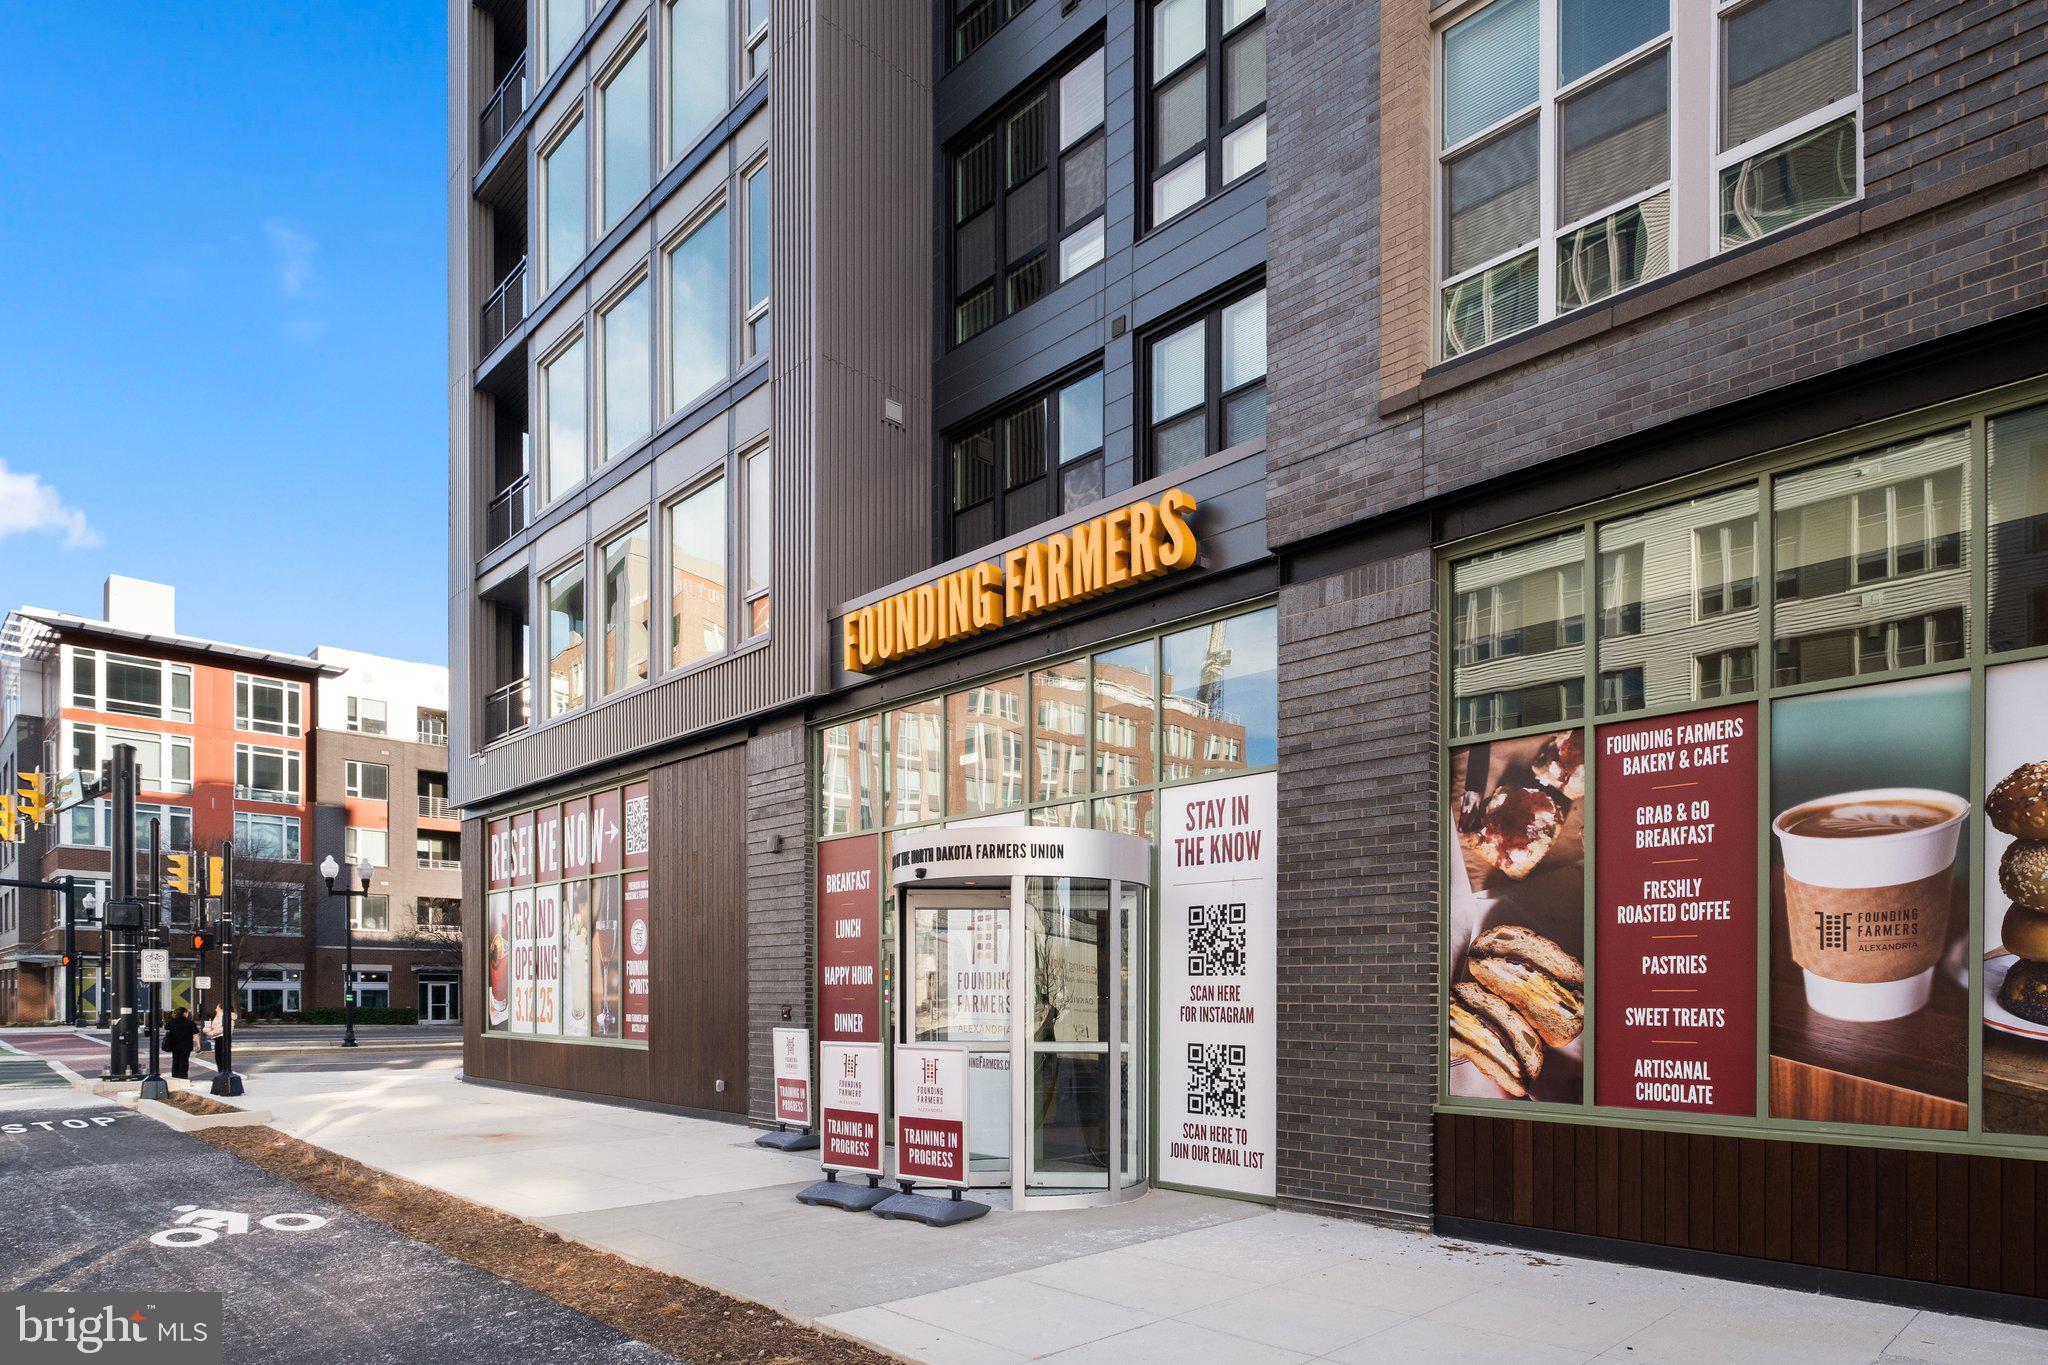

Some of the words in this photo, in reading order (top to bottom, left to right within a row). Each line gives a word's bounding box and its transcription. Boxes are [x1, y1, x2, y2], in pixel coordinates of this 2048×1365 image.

[844, 561, 1003, 672] FOUNDING
[1006, 488, 1197, 622] FARMERS
[1607, 727, 1672, 755] FOUNDING
[1677, 717, 1744, 745] FARMERS
[1623, 751, 1676, 776] BAKERY
[1679, 749, 1690, 769] &
[1693, 744, 1729, 767] CAFE
[1186, 798, 1226, 831] STAY
[1232, 795, 1249, 826] IN
[1636, 804, 1672, 826] GRAB
[1677, 802, 1687, 822] &
[1691, 800, 1710, 820] GO
[564, 808, 605, 868] NOW
[1636, 823, 1715, 849] BREAKFAST
[911, 847, 934, 864] NORTH
[936, 845, 972, 862] DAKOTA
[976, 843, 1027, 860] FARMERS
[1030, 844, 1064, 859] UNION
[1175, 836, 1205, 867] THE
[1210, 830, 1261, 864] KNOW
[826, 870, 871, 894] BREAKFAST
[1643, 877, 1702, 900] FRESHLY
[1617, 903, 1677, 924] ROASTED
[1680, 900, 1731, 922] COFFEE
[1858, 908, 1918, 923] FOUNDING
[835, 918, 861, 939] LUNCH
[1858, 923, 1918, 937] FARMERS
[1858, 942, 1918, 952] ALEXANDRIA
[515, 945, 558, 981] OPENING
[626, 960, 649, 976] FOUNDIN
[1642, 955, 1708, 975] PASTRIES
[824, 967, 851, 986] HAPPY
[851, 965, 873, 985] HOUR
[958, 994, 1011, 1013] FARMERS
[1190, 985, 1214, 1001] SCAN
[1217, 985, 1241, 1002] HERE
[834, 1013, 863, 1033] DINNER
[1180, 1006, 1197, 1023] FOR
[1199, 1007, 1254, 1024] INSTAGRAM
[1625, 1007, 1669, 1027] SWEET
[1672, 1008, 1725, 1028] TREATS
[1634, 1058, 1711, 1081] ARTISANAL
[780, 1085, 799, 1099] TRAINING
[839, 1079, 862, 1089] FOUNDING
[839, 1088, 862, 1098] FARMERS
[917, 1086, 943, 1096] FOUNDING
[1635, 1082, 1713, 1105] CHOCOLATE
[782, 1099, 803, 1113] PROGRESS
[917, 1095, 943, 1105] FARMERS
[1, 1117, 116, 1134] STOP
[828, 1119, 862, 1137] TRAINING
[865, 1123, 873, 1139] IN
[1183, 1122, 1207, 1141] SCAN
[1210, 1125, 1233, 1144] HERE
[1236, 1128, 1248, 1145] TO
[831, 1137, 869, 1157] PROGRESS
[904, 1128, 945, 1147] TRAINING
[947, 1132, 958, 1149] IN
[909, 1149, 953, 1168] PROGRESS
[1170, 1142, 1189, 1160] JOIN
[1191, 1144, 1210, 1163] OUR
[1212, 1146, 1241, 1167] EMAIL
[1243, 1151, 1264, 1170] LIST
